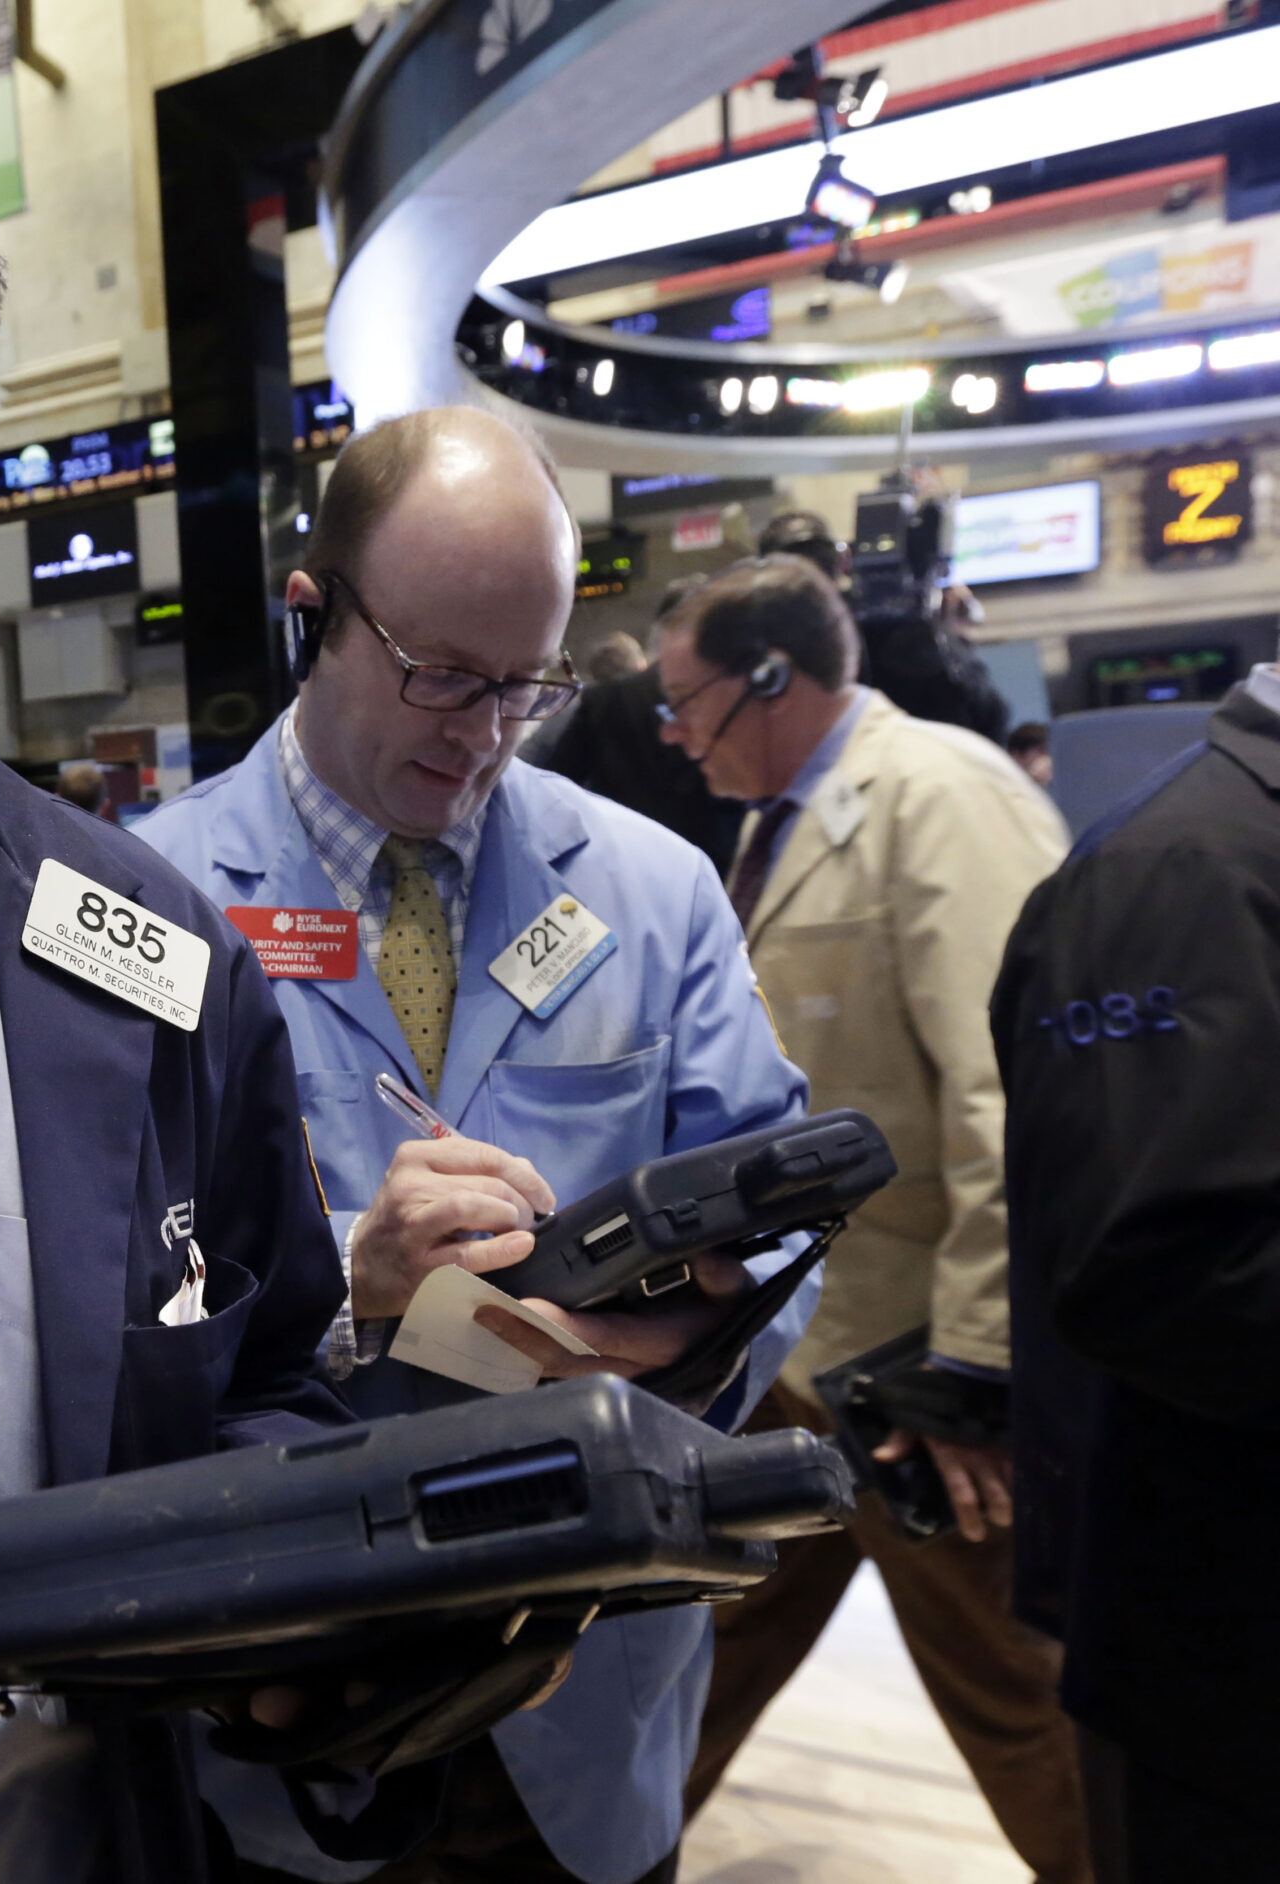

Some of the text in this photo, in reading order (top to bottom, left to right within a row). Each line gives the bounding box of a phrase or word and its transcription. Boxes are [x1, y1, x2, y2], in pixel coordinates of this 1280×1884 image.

[76, 891, 167, 964] 835
[296, 914, 321, 923] NYSE
[296, 923, 348, 933] EURONEXT
[56, 923, 175, 992] GLENN M. KESSLER
[251, 939, 342, 952] URITY AND SAFETY
[257, 951, 316, 962] COMMITTEE
[517, 916, 567, 968] 221
[31, 935, 86, 970] QUATTRO
[88, 964, 100, 979] M.
[170, 1006, 188, 1023] INC.
